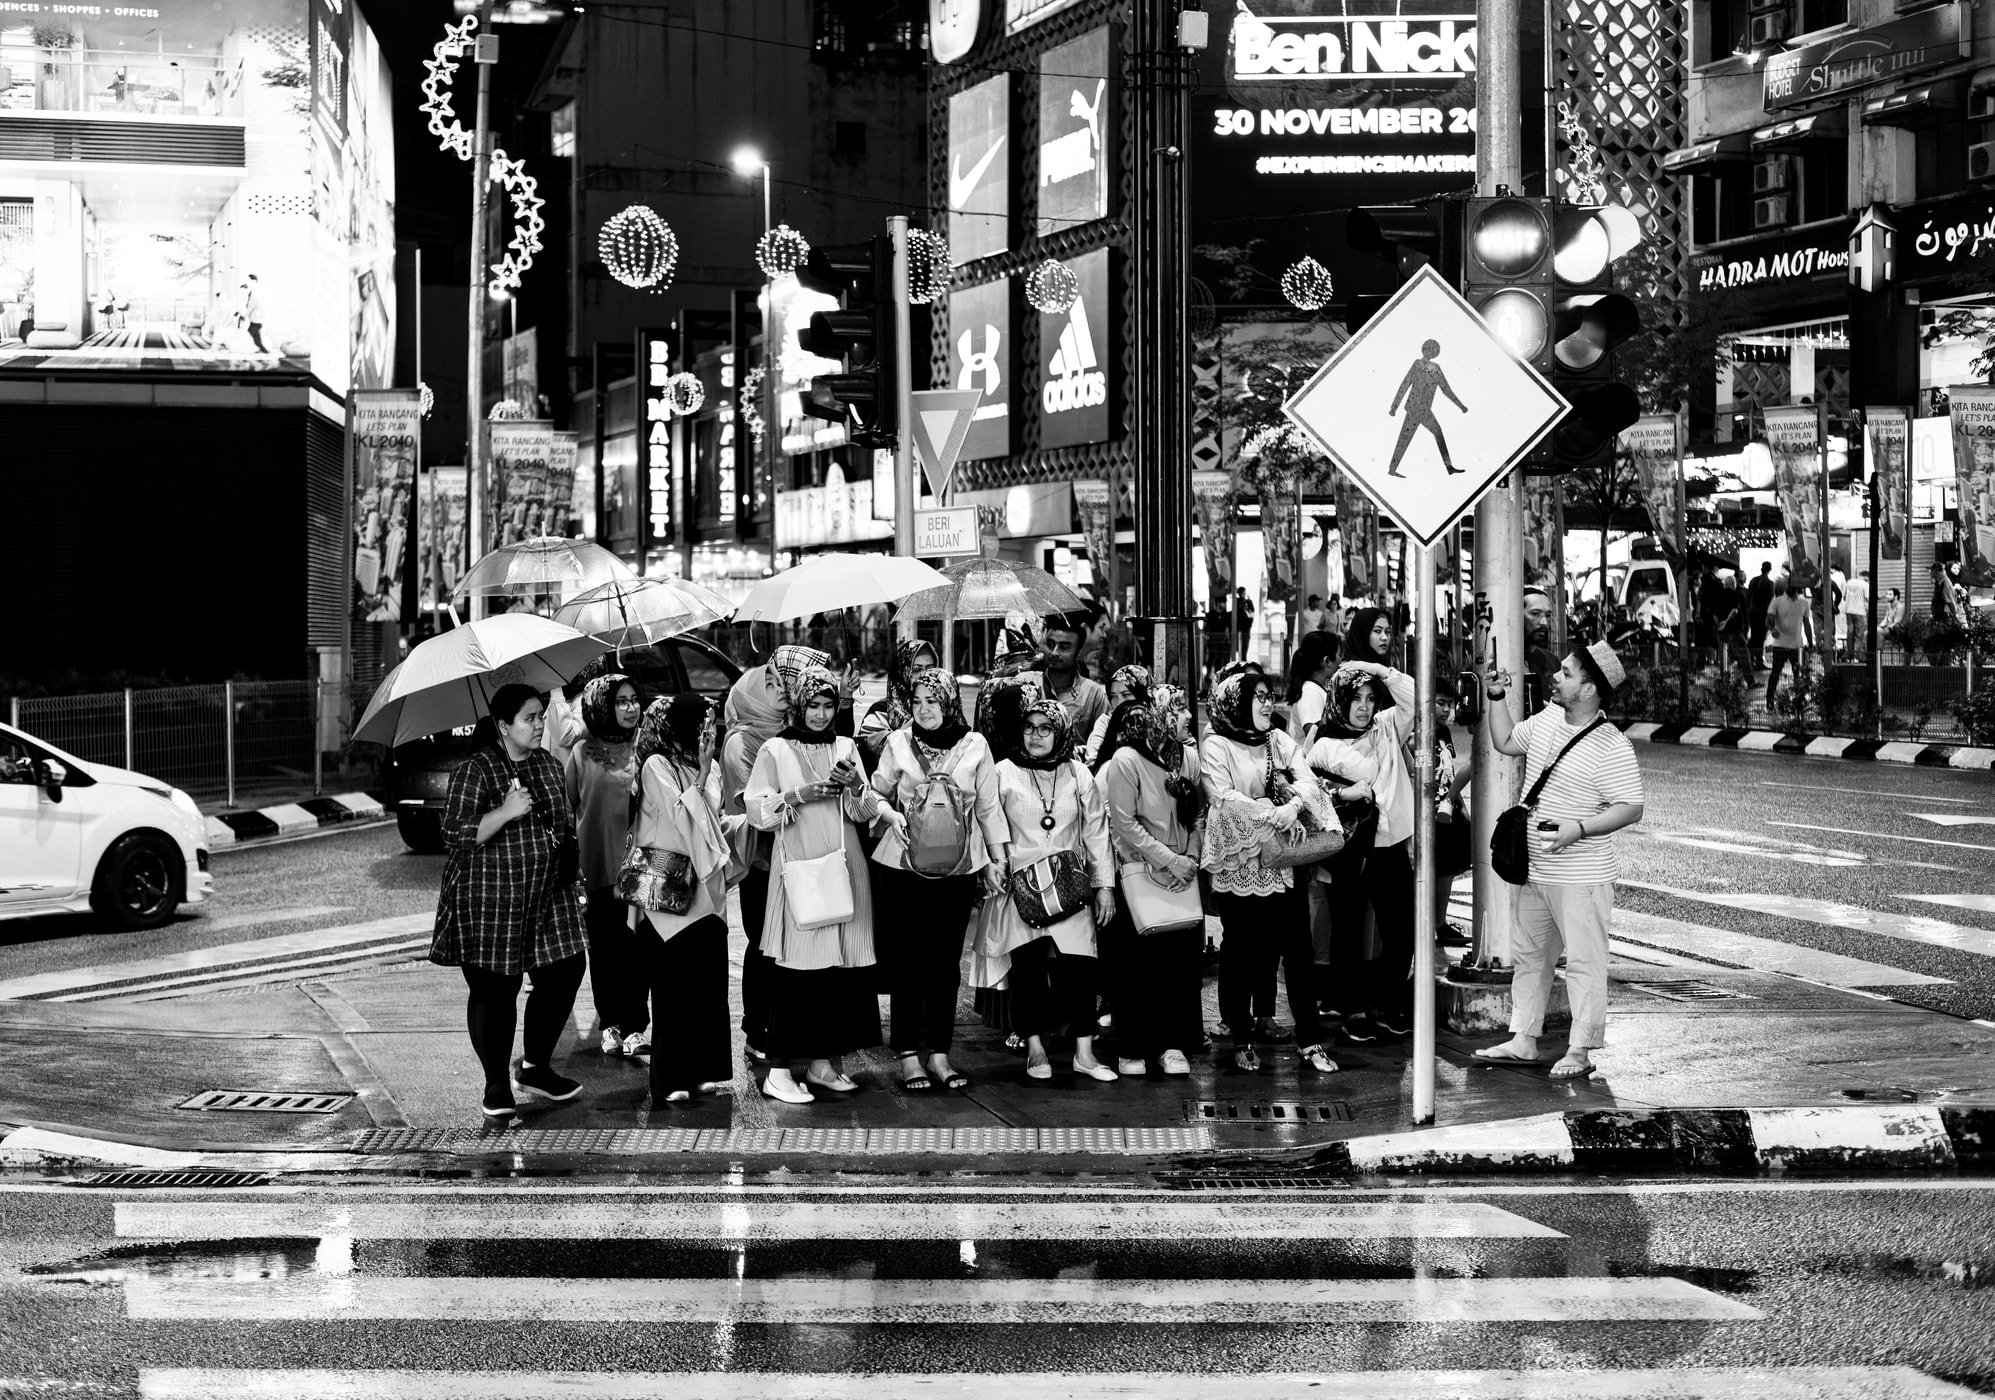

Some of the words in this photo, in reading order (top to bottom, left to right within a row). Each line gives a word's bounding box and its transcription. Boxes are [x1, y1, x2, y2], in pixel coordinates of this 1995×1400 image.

[53, 4, 101, 15] SHOPPES
[114, 7, 159, 18] OFFICES
[1234, 22, 1342, 74] Ben
[1769, 57, 1801, 82] BUDGET
[1810, 51, 1884, 93] Shuttle
[1768, 78, 1793, 100] HOTEL
[1213, 109, 1255, 135] 30
[1260, 107, 1443, 135] NOVEMBER
[1481, 231, 1540, 252] WAIT
[1699, 247, 1819, 292] HADRAMOT
[1042, 368, 1106, 414] adidas
[1951, 402, 1969, 412] KITA
[359, 409, 376, 420] KITA
[378, 409, 419, 420] RANCANG
[388, 422, 409, 432] PLAN
[1767, 423, 1783, 432] KITA
[1955, 424, 1974, 437] KL
[358, 434, 378, 449] KL
[379, 434, 415, 449] 2040
[512, 437, 552, 447] RANCANG
[1795, 431, 1813, 440] PLAN
[522, 447, 541, 456] PLAN
[1634, 448, 1651, 460] KL
[1773, 442, 1790, 454] KL
[496, 457, 510, 470] KL
[513, 458, 546, 471] 2040
[647, 398, 672, 538] MARKET
[927, 515, 951, 531] BERI
[918, 533, 960, 549] LALUAN
